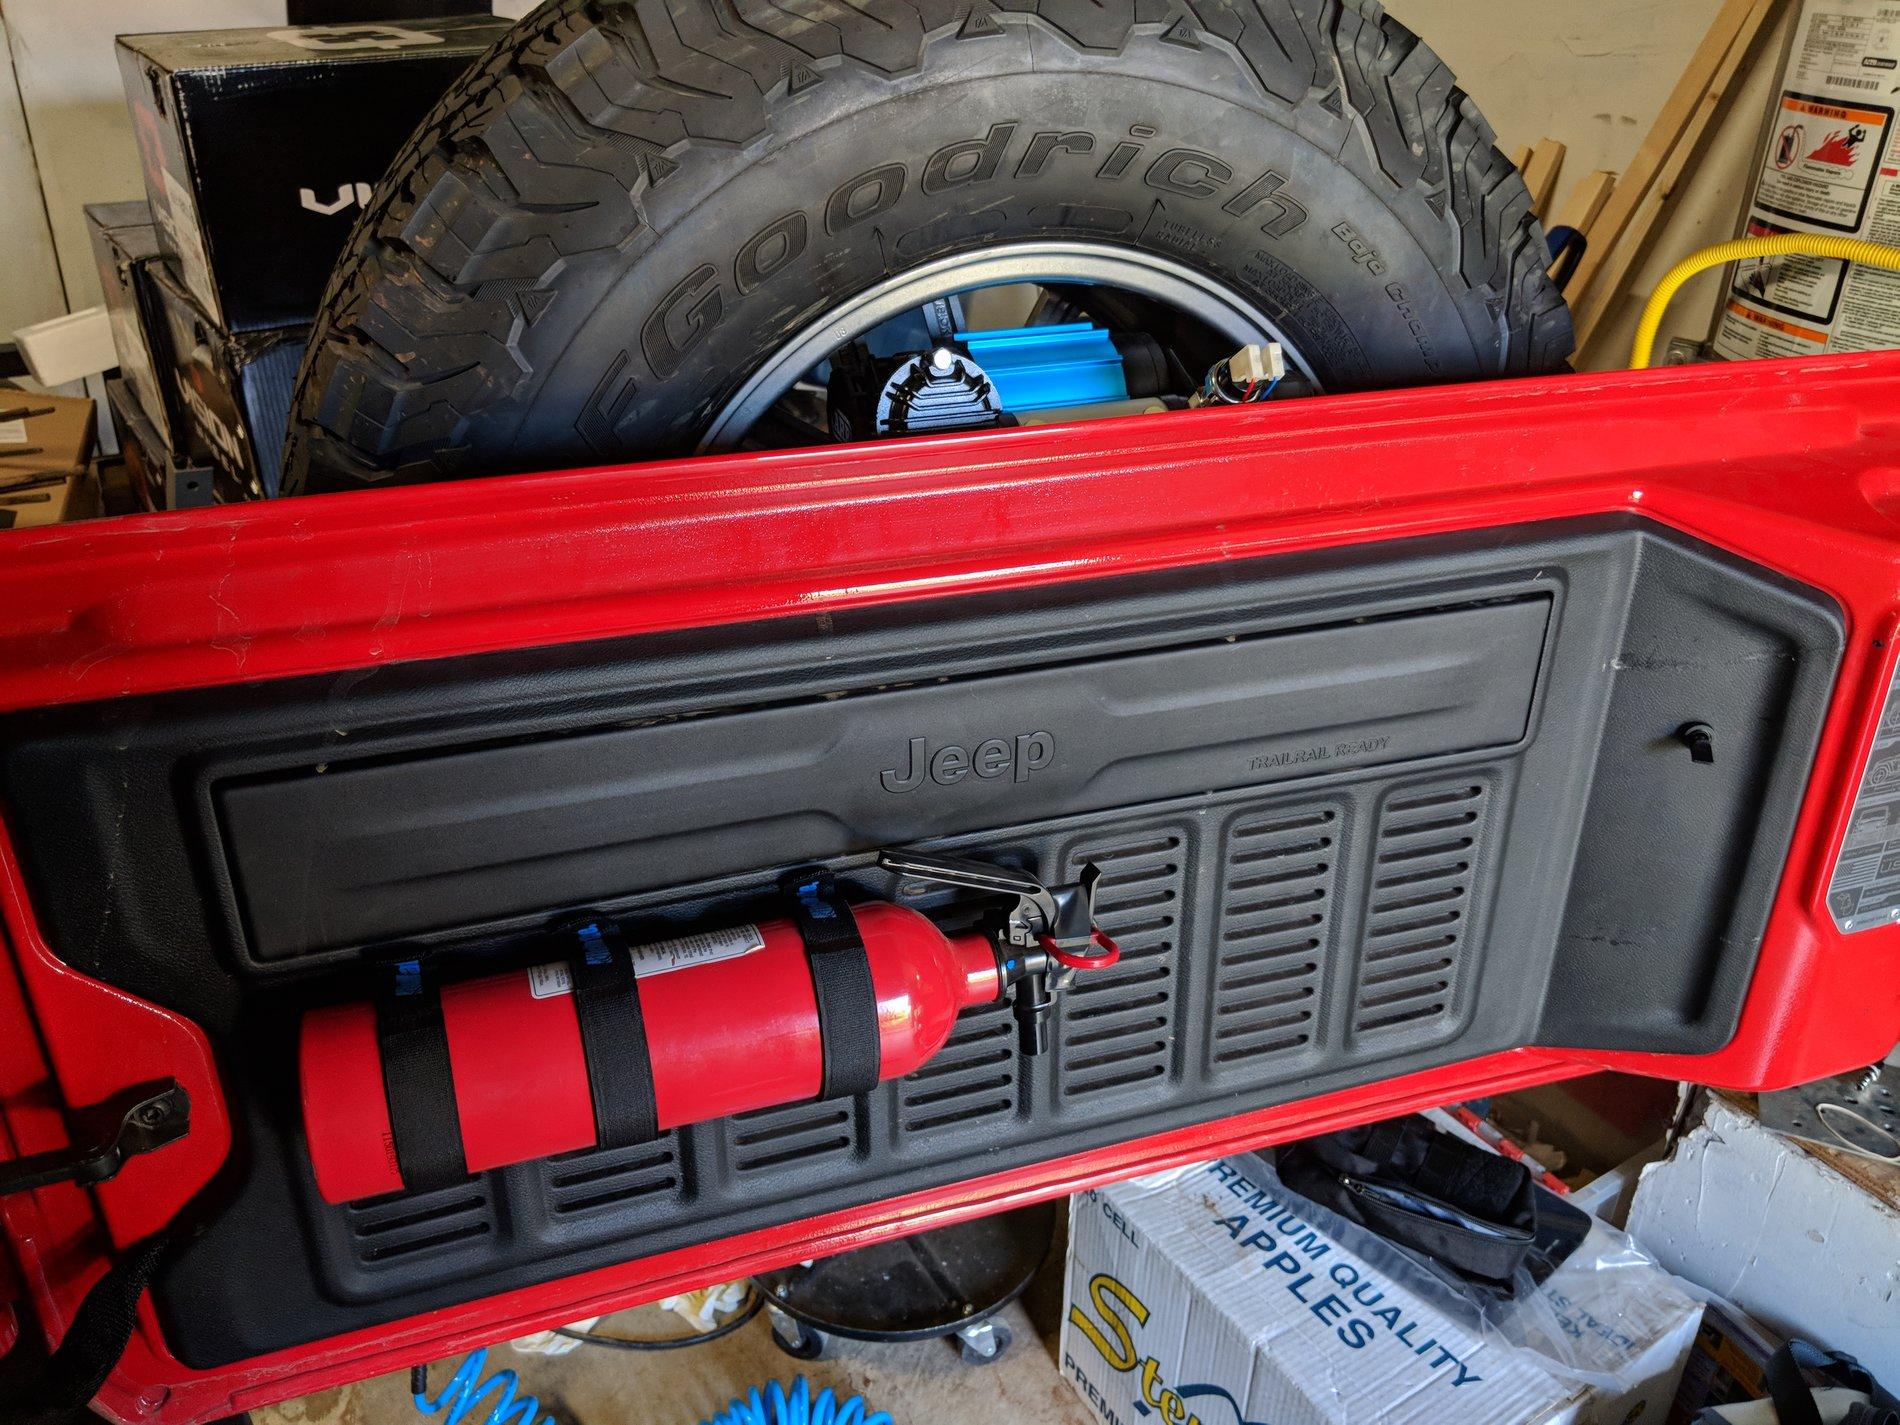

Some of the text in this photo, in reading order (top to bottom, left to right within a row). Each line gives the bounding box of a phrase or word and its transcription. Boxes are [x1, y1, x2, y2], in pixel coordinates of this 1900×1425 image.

[1806, 104, 1848, 120] WARNING
[1330, 220, 1386, 277] Baja
[879, 729, 1056, 794] Jeep
[1246, 735, 1392, 772] TRAILRAIL READY
[1102, 1203, 1140, 1249] CELL
[1214, 1214, 1376, 1350] APPLES
[1328, 1262, 1483, 1388] QUALITY
[1064, 1351, 1125, 1425] PREMI
